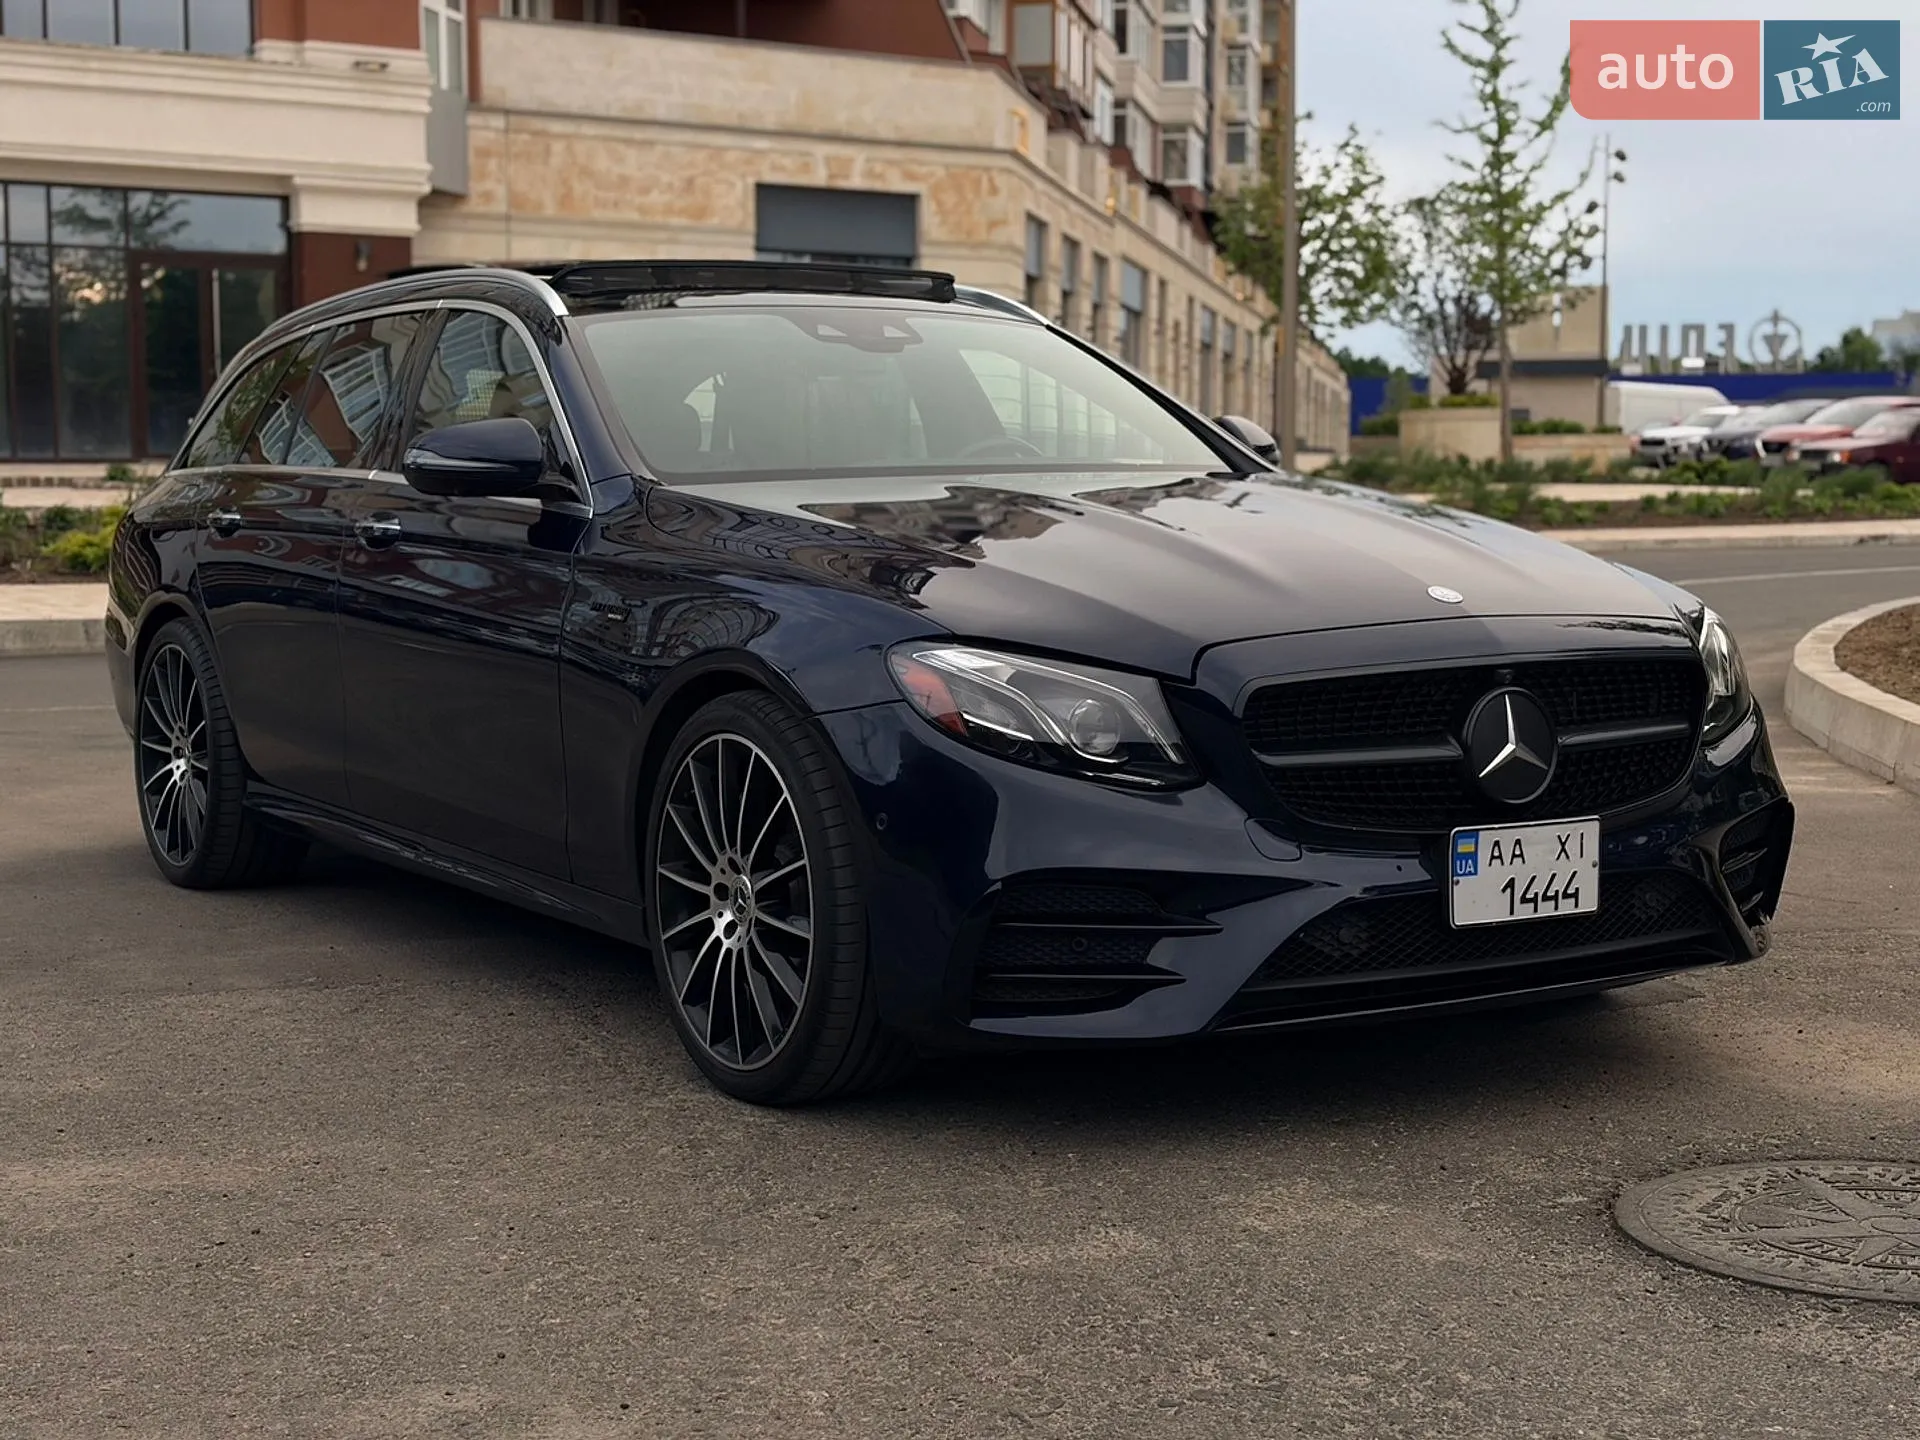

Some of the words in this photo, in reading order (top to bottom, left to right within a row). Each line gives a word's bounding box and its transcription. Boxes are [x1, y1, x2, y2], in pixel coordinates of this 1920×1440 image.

[1456, 859, 1475, 874] UA
[1488, 837, 1526, 867] AA
[1555, 832, 1584, 862] XI
[1500, 870, 1580, 916] 1444
